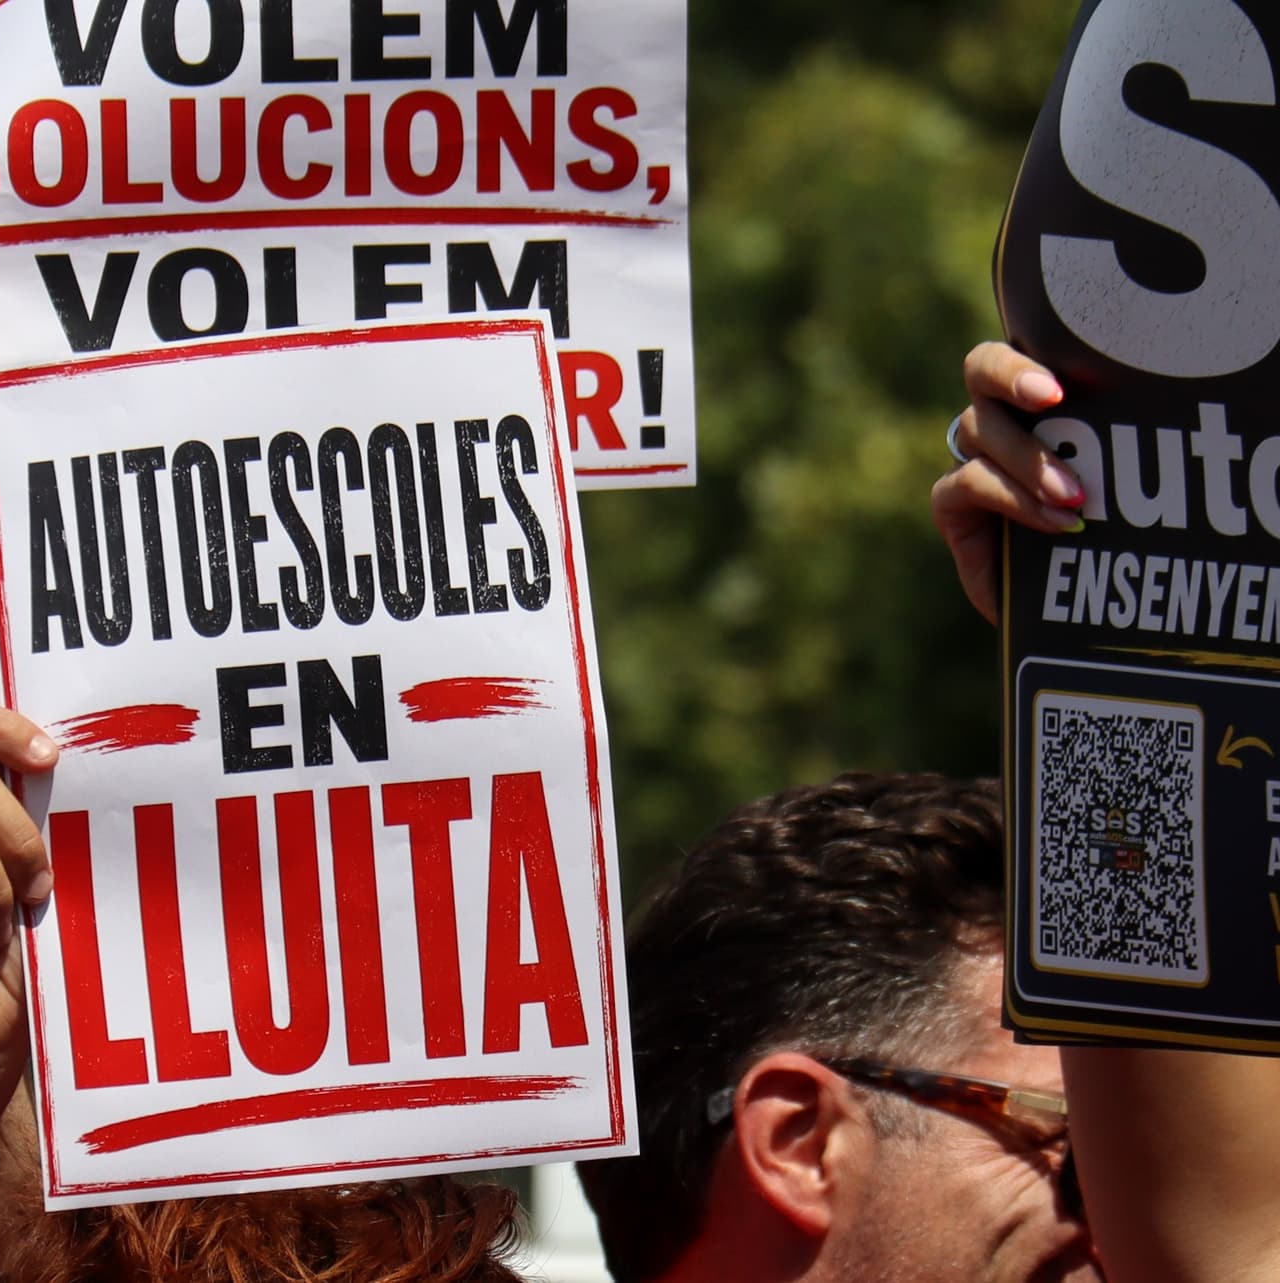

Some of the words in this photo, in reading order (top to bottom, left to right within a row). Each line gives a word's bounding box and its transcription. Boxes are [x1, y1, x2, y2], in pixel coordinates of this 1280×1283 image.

[44, 0, 568, 87] VOLEM
[27, 414, 552, 653] AUTOESCOLES
[215, 654, 389, 774] EN
[48, 771, 589, 1090] LLUITA
